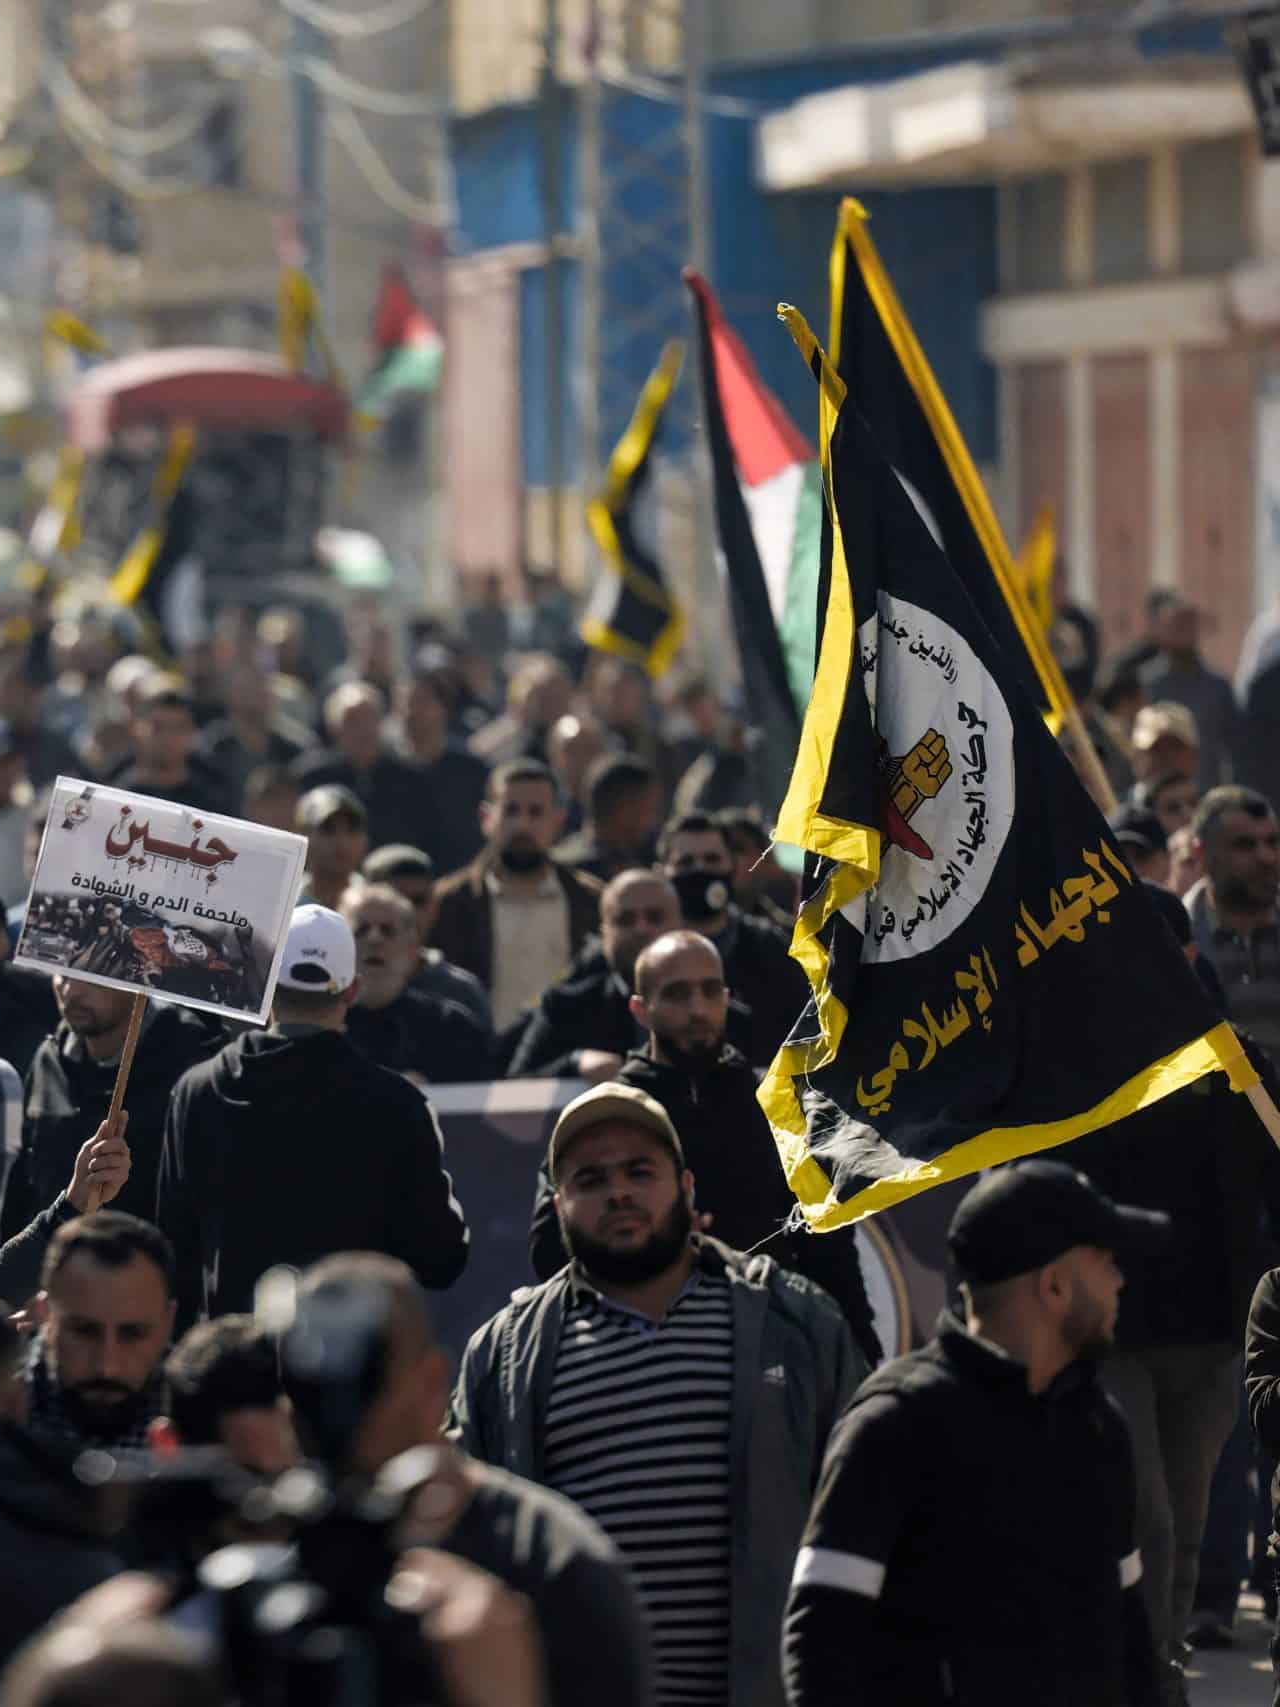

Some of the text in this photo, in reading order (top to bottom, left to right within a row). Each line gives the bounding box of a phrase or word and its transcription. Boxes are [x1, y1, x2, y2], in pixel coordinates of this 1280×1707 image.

[957, 701, 988, 786] حركة
[104, 805, 238, 883] جنين
[957, 791, 989, 866] الجهاد
[71, 873, 249, 928] ملحمة الدم و الشهادة
[856, 838, 1134, 1117] الجهاد الإسلامي
